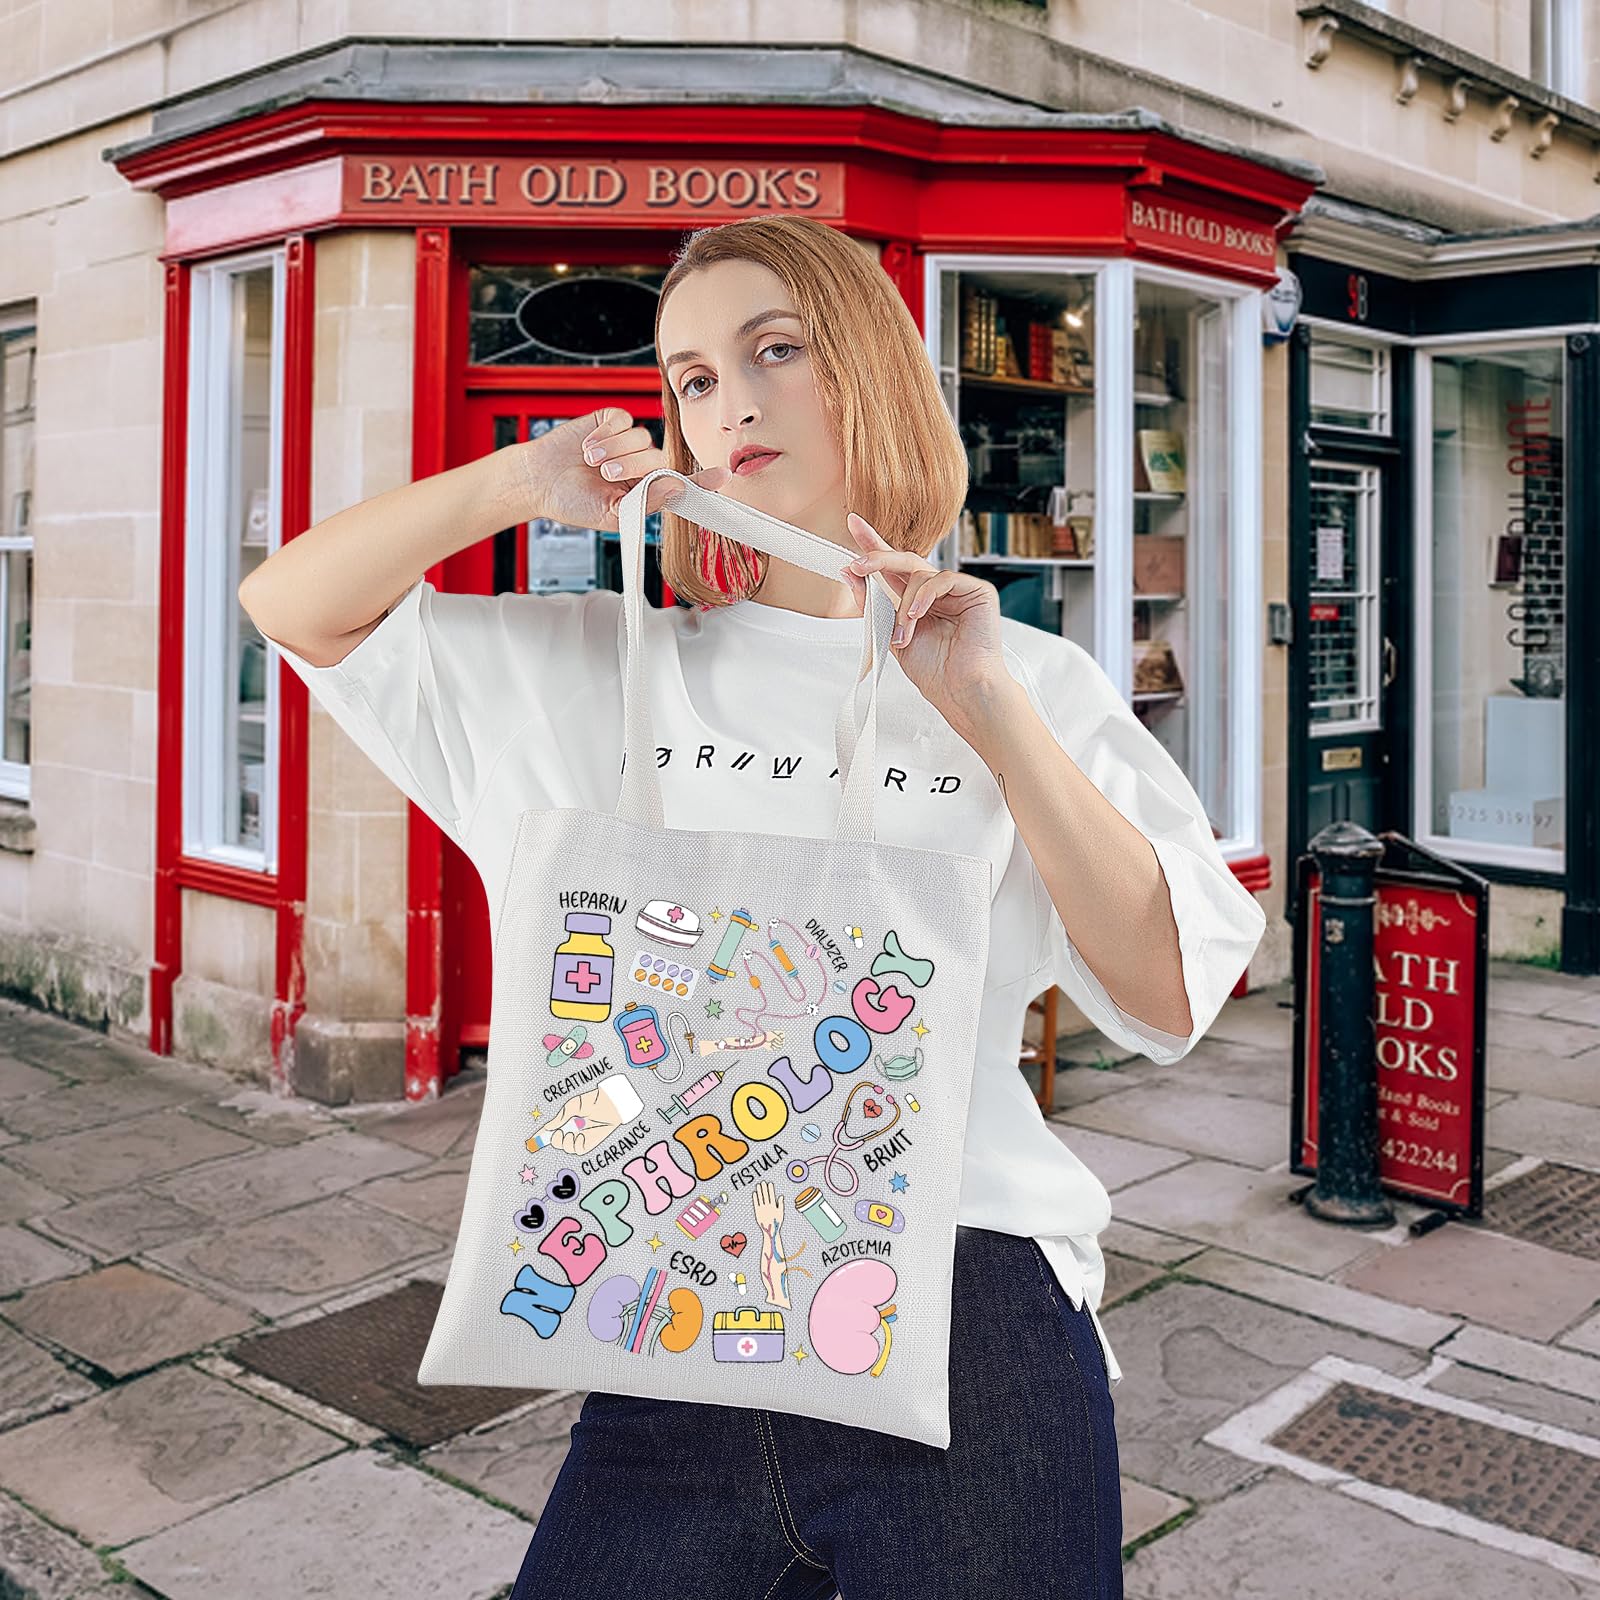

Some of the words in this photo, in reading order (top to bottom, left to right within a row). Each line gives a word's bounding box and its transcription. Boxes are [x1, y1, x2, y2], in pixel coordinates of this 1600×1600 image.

[361, 162, 499, 205] BATH
[519, 164, 627, 206] OLD
[646, 166, 820, 209] BOOKS
[1131, 201, 1184, 236] BATH
[1186, 217, 1222, 244] OLD
[1224, 225, 1274, 257] BOOKS
[559, 891, 627, 915] HEPARIN
[805, 918, 848, 973] DIALYZER
[1376, 990, 1434, 1032] LD
[543, 1056, 613, 1102] CREATININE
[1376, 1036, 1458, 1082] OKS
[1408, 1111, 1440, 1131] Sold
[1417, 1093, 1460, 1116] Books
[500, 929, 935, 1339] NEPHROLOGY
[581, 1120, 651, 1176] CLEARANCE
[863, 1128, 913, 1173] BRUIT
[1381, 1138, 1458, 1174] 422244
[730, 1144, 788, 1191] FISTULA
[670, 1250, 717, 1287] ESRD
[821, 1239, 892, 1267] AZOTEMIA
